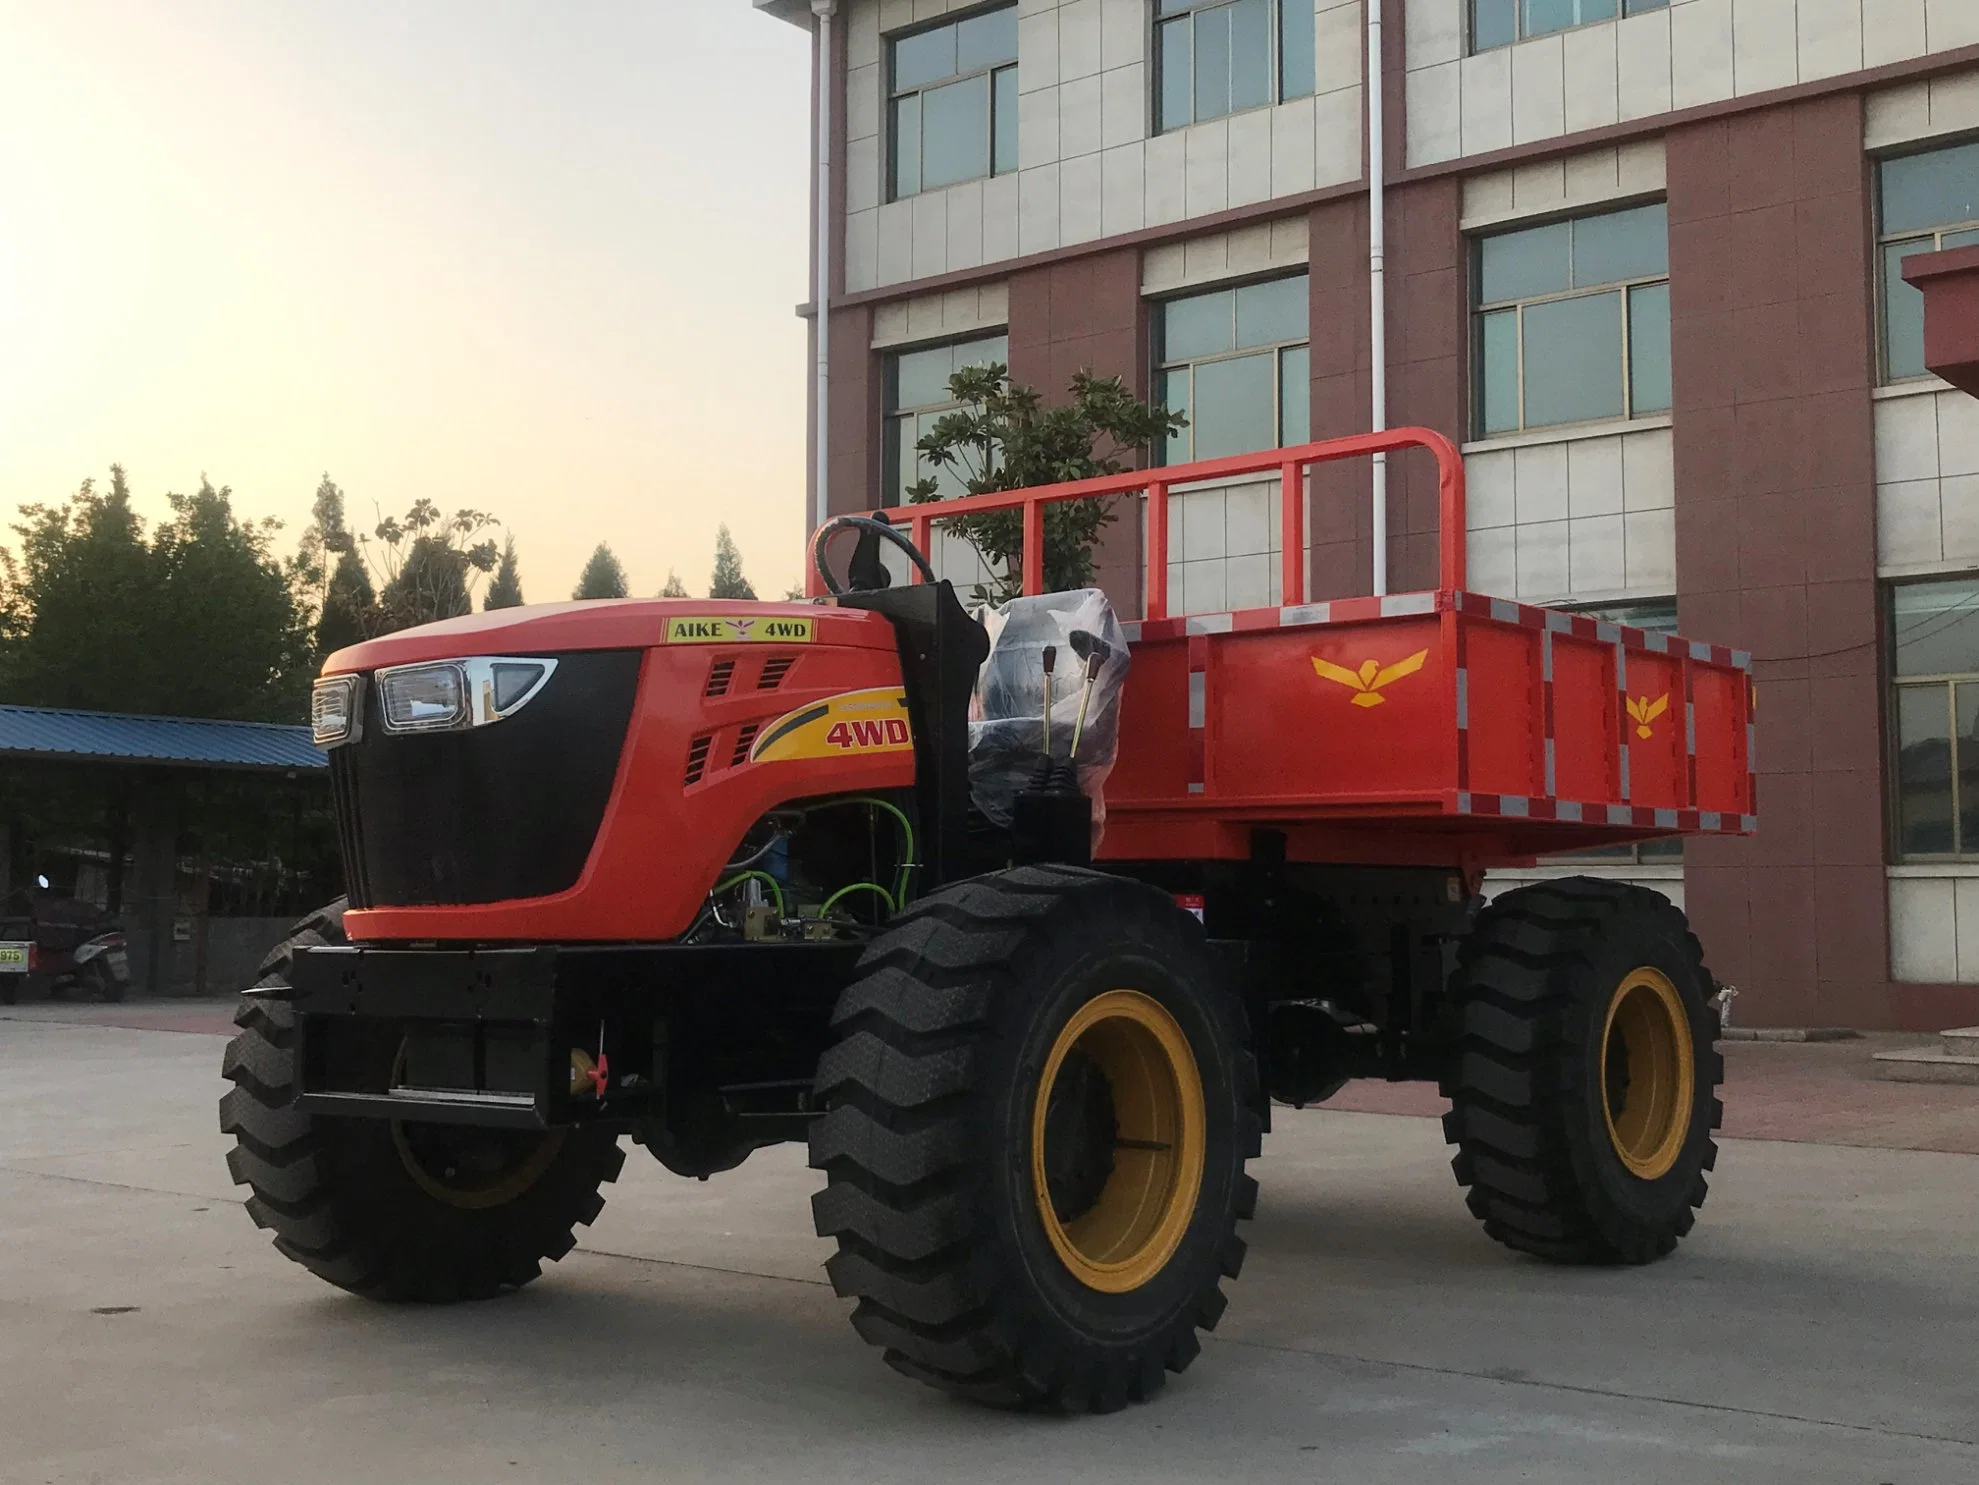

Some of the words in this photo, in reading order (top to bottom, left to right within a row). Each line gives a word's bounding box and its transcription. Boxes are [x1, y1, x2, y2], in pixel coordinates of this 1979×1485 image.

[674, 622, 723, 637] AIKE
[765, 622, 806, 637] 4WD
[826, 718, 910, 748] 4WD
